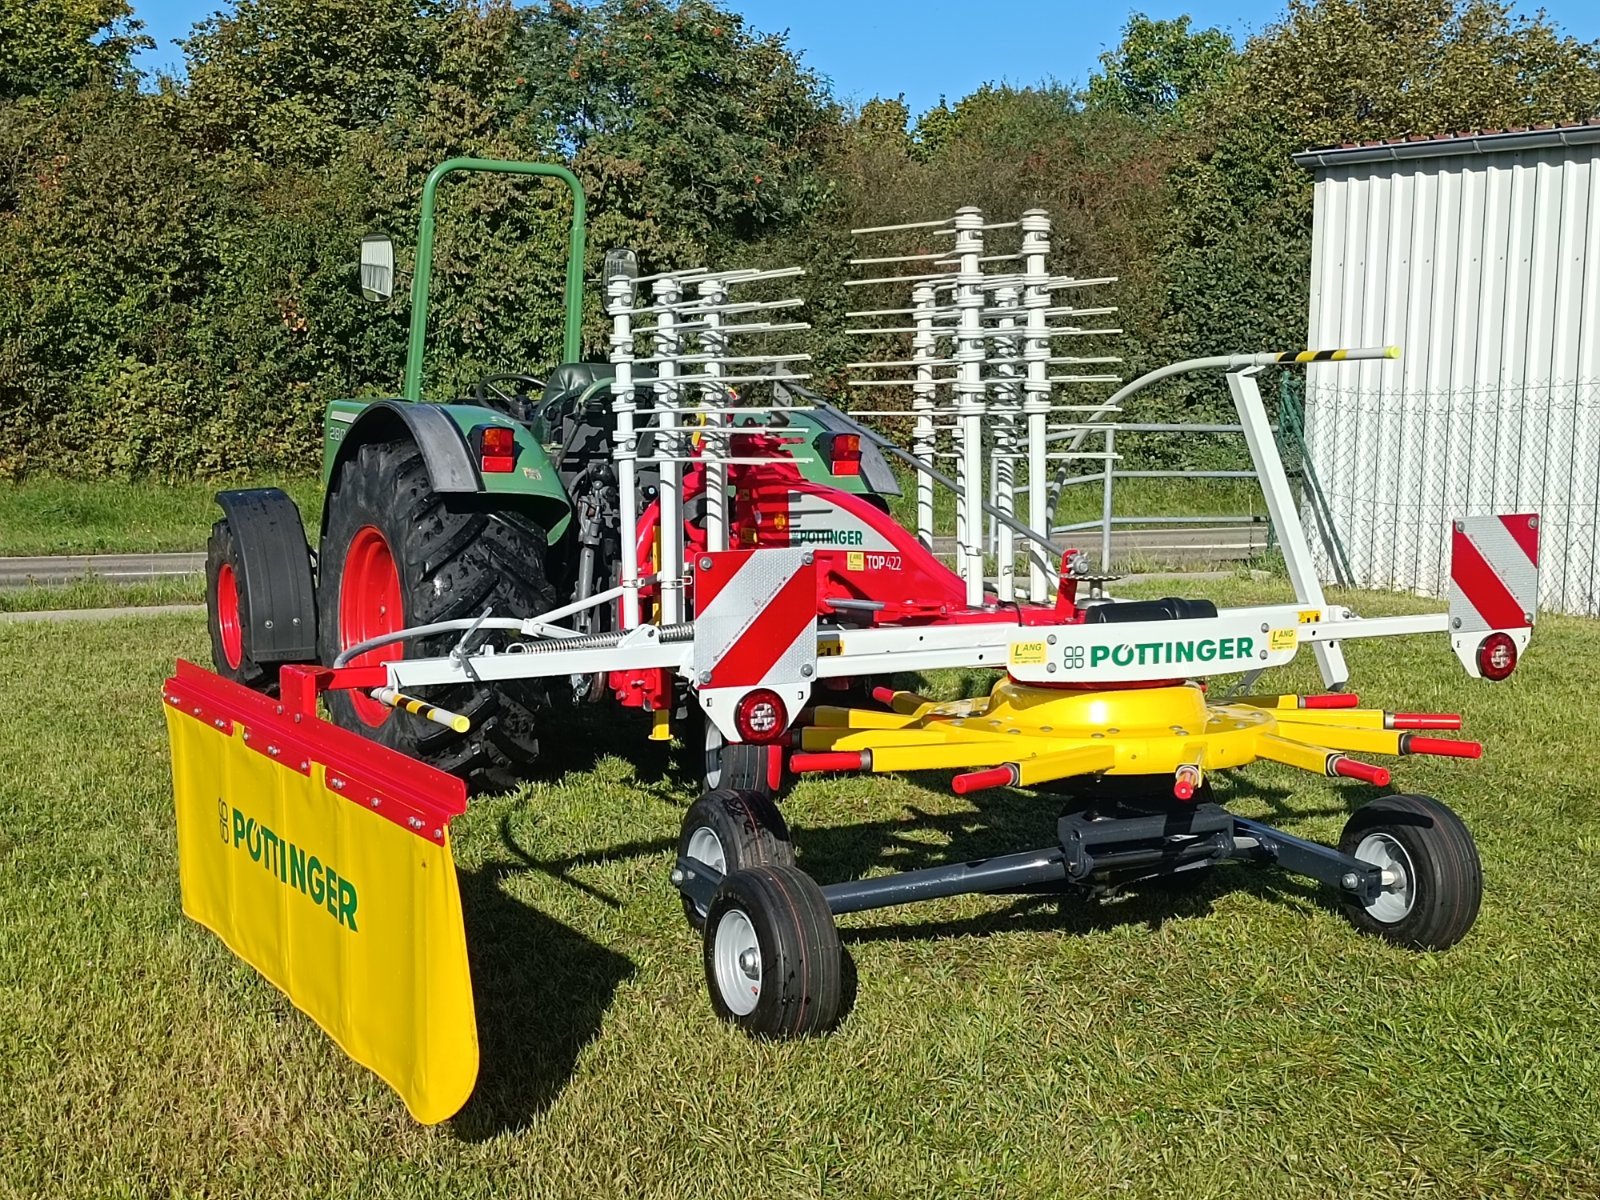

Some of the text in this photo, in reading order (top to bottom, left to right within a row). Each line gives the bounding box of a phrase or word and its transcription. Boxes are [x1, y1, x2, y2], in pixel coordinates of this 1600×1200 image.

[866, 555, 885, 569] TOP
[886, 556, 902, 570] 422
[1273, 629, 1294, 643] LANG
[1014, 643, 1042, 656] LANG
[1090, 637, 1254, 668] PÖTTINGER
[232, 807, 359, 933] PÖTTINGER
